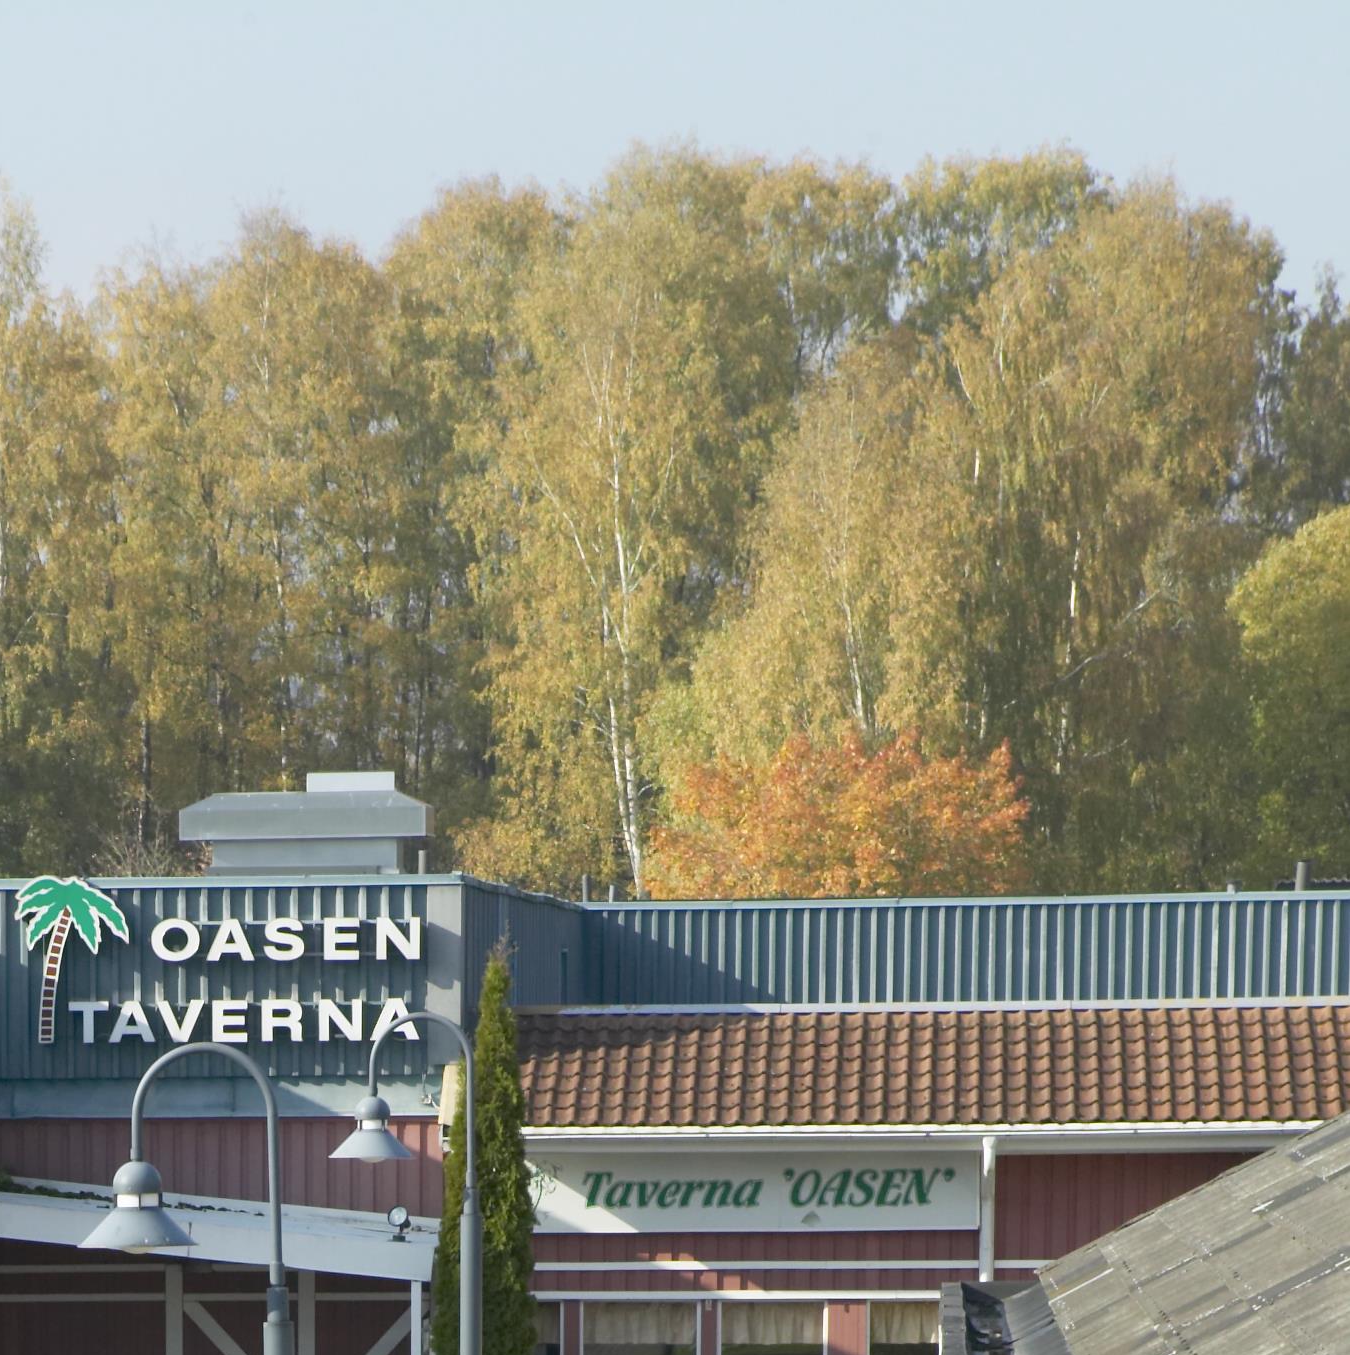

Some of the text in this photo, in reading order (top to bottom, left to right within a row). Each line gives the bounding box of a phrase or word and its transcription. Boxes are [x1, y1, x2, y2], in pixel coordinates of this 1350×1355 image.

[151, 916, 421, 961] OASEN
[69, 997, 420, 1044] TAVERNA
[583, 1171, 764, 1210] Taverna
